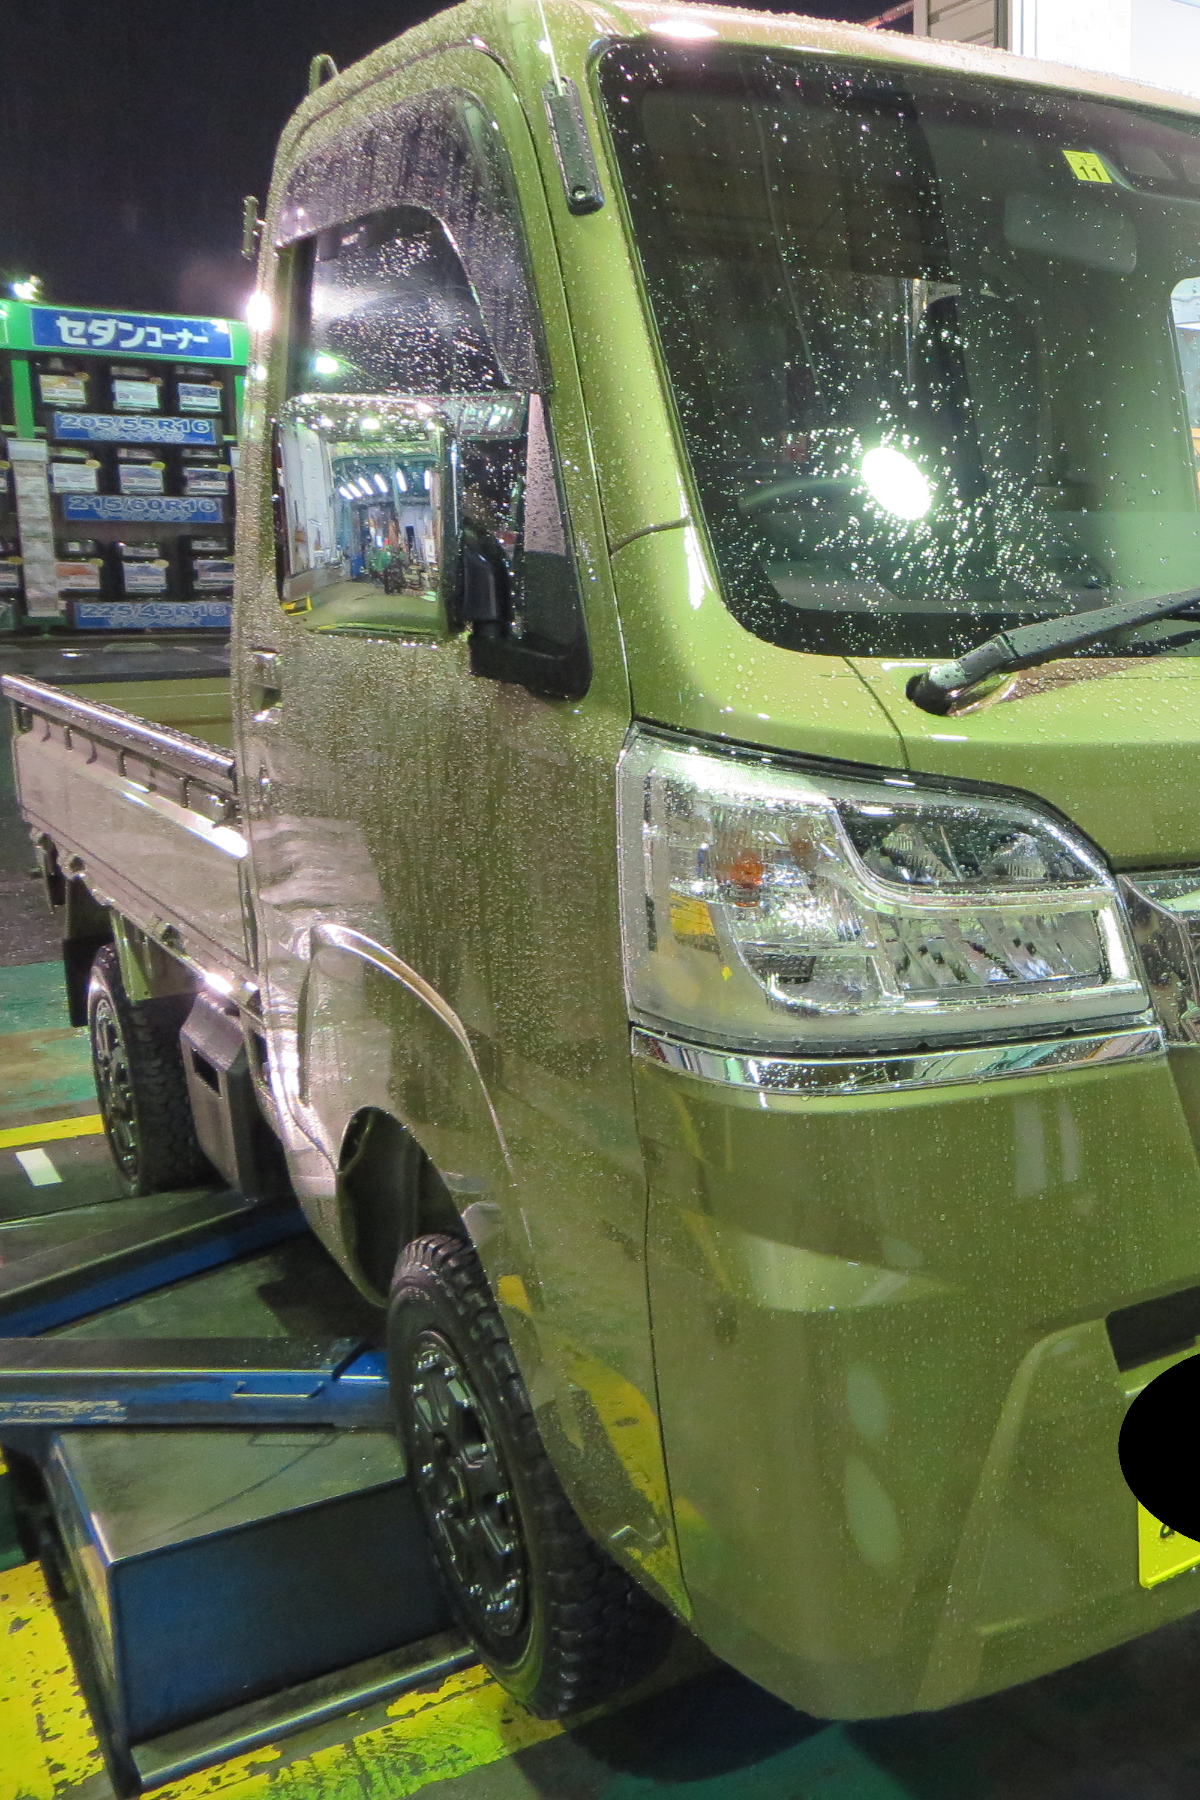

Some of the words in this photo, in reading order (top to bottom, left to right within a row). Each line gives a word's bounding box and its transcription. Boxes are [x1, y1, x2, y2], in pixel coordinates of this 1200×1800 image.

[1079, 165, 1103, 181] 11
[55, 315, 210, 350] セダンコーナー
[60, 415, 211, 434] 205/55R16
[68, 495, 218, 513] 215/60R16
